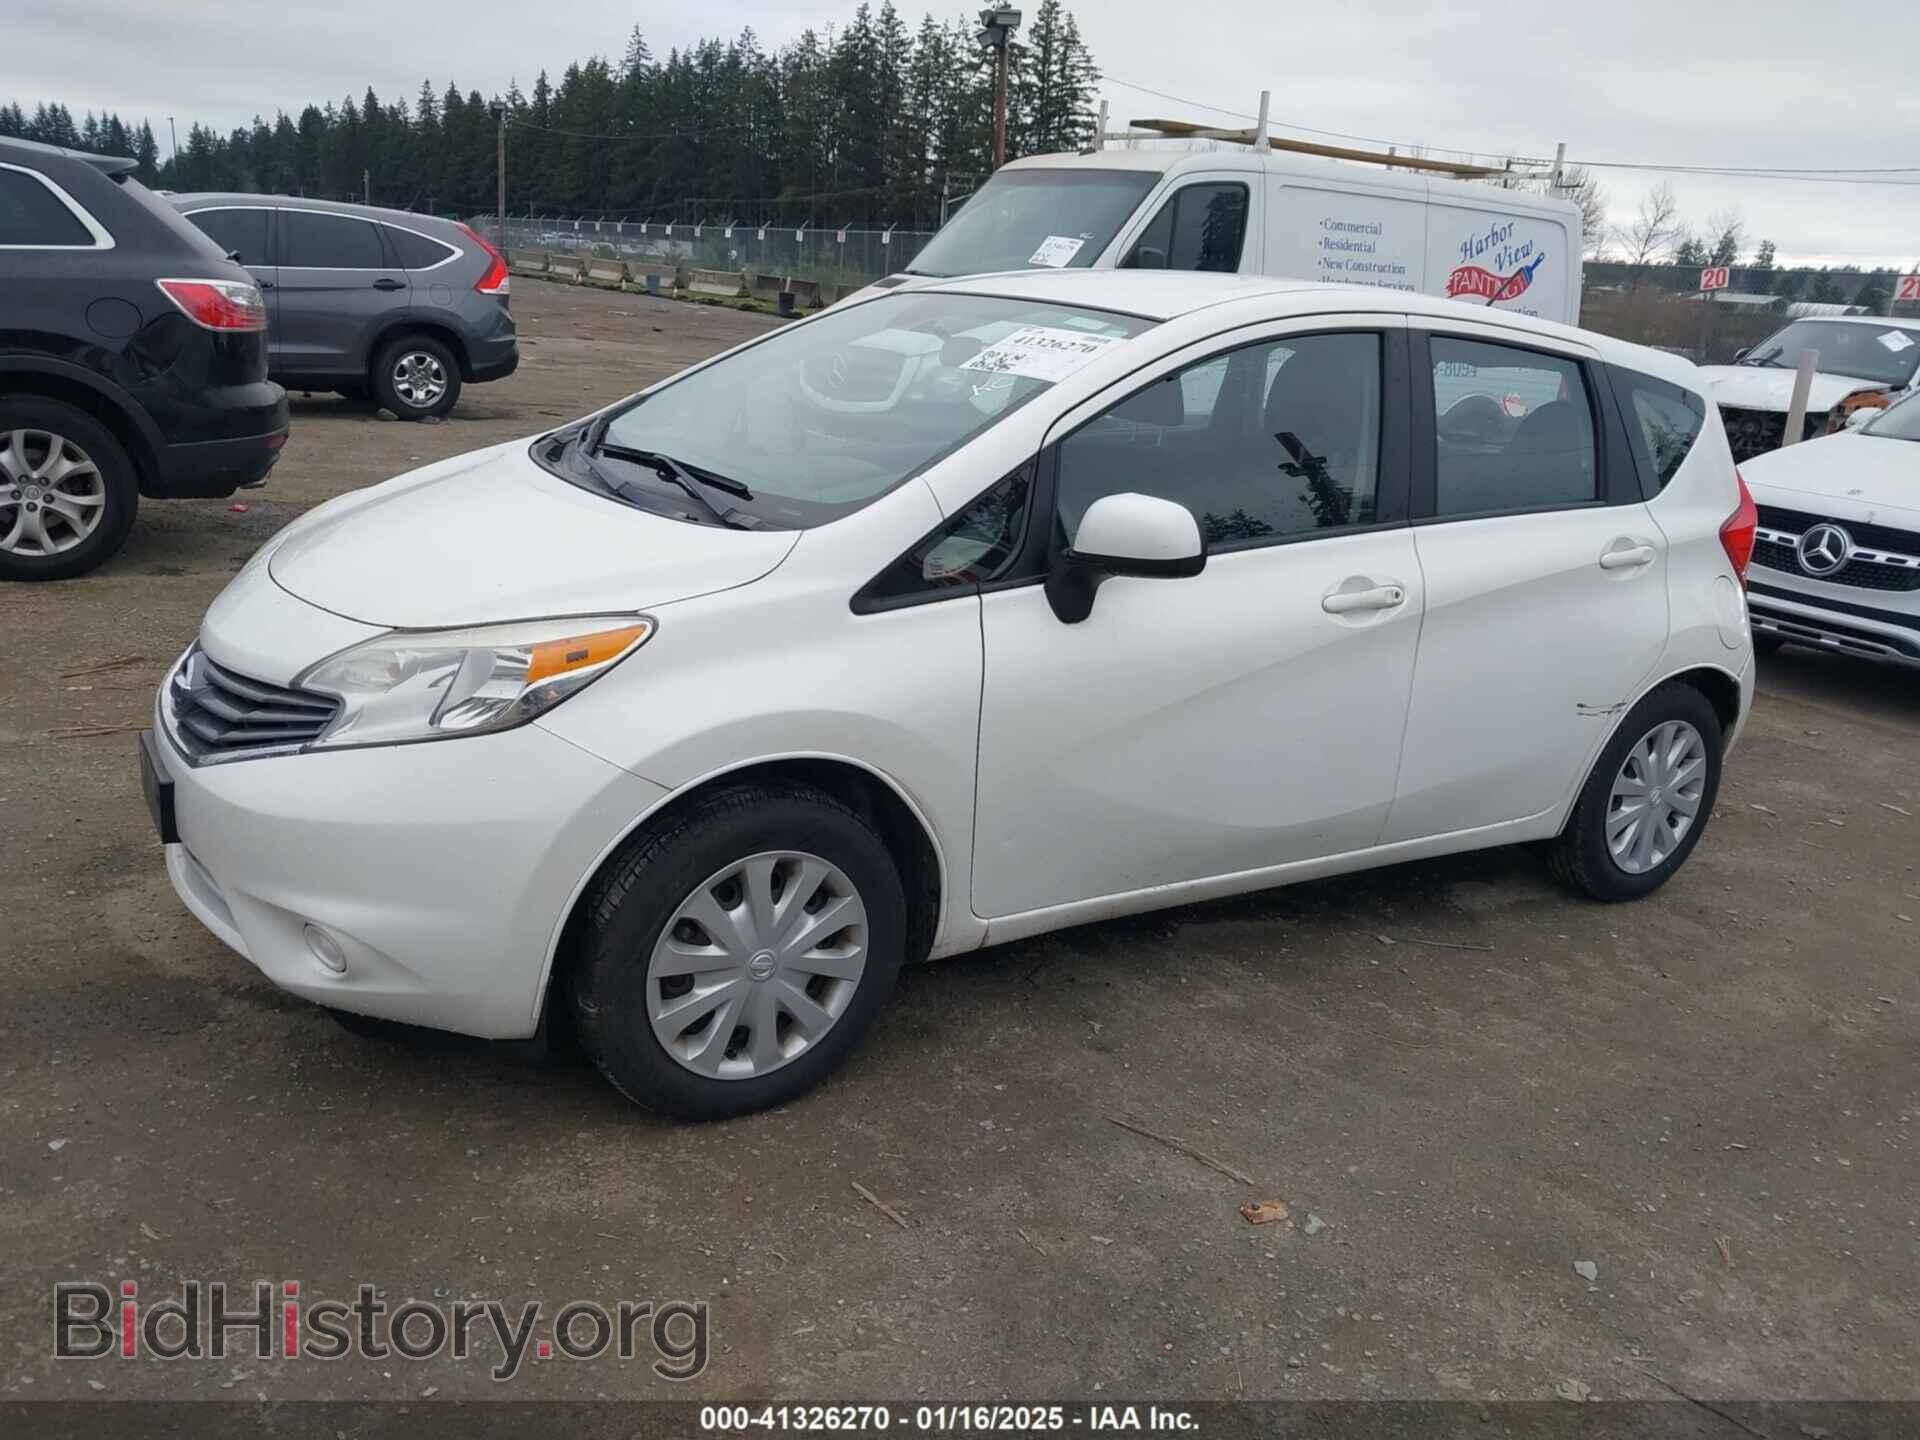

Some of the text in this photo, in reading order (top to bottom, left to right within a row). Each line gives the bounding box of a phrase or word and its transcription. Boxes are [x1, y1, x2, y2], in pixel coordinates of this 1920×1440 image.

[1324, 218, 1382, 235] Commercial
[1323, 238, 1376, 254] Residential
[1459, 221, 1514, 265] Harbor
[1494, 239, 1534, 272] View
[1322, 257, 1406, 275] New Construction
[1703, 269, 1727, 289] 20
